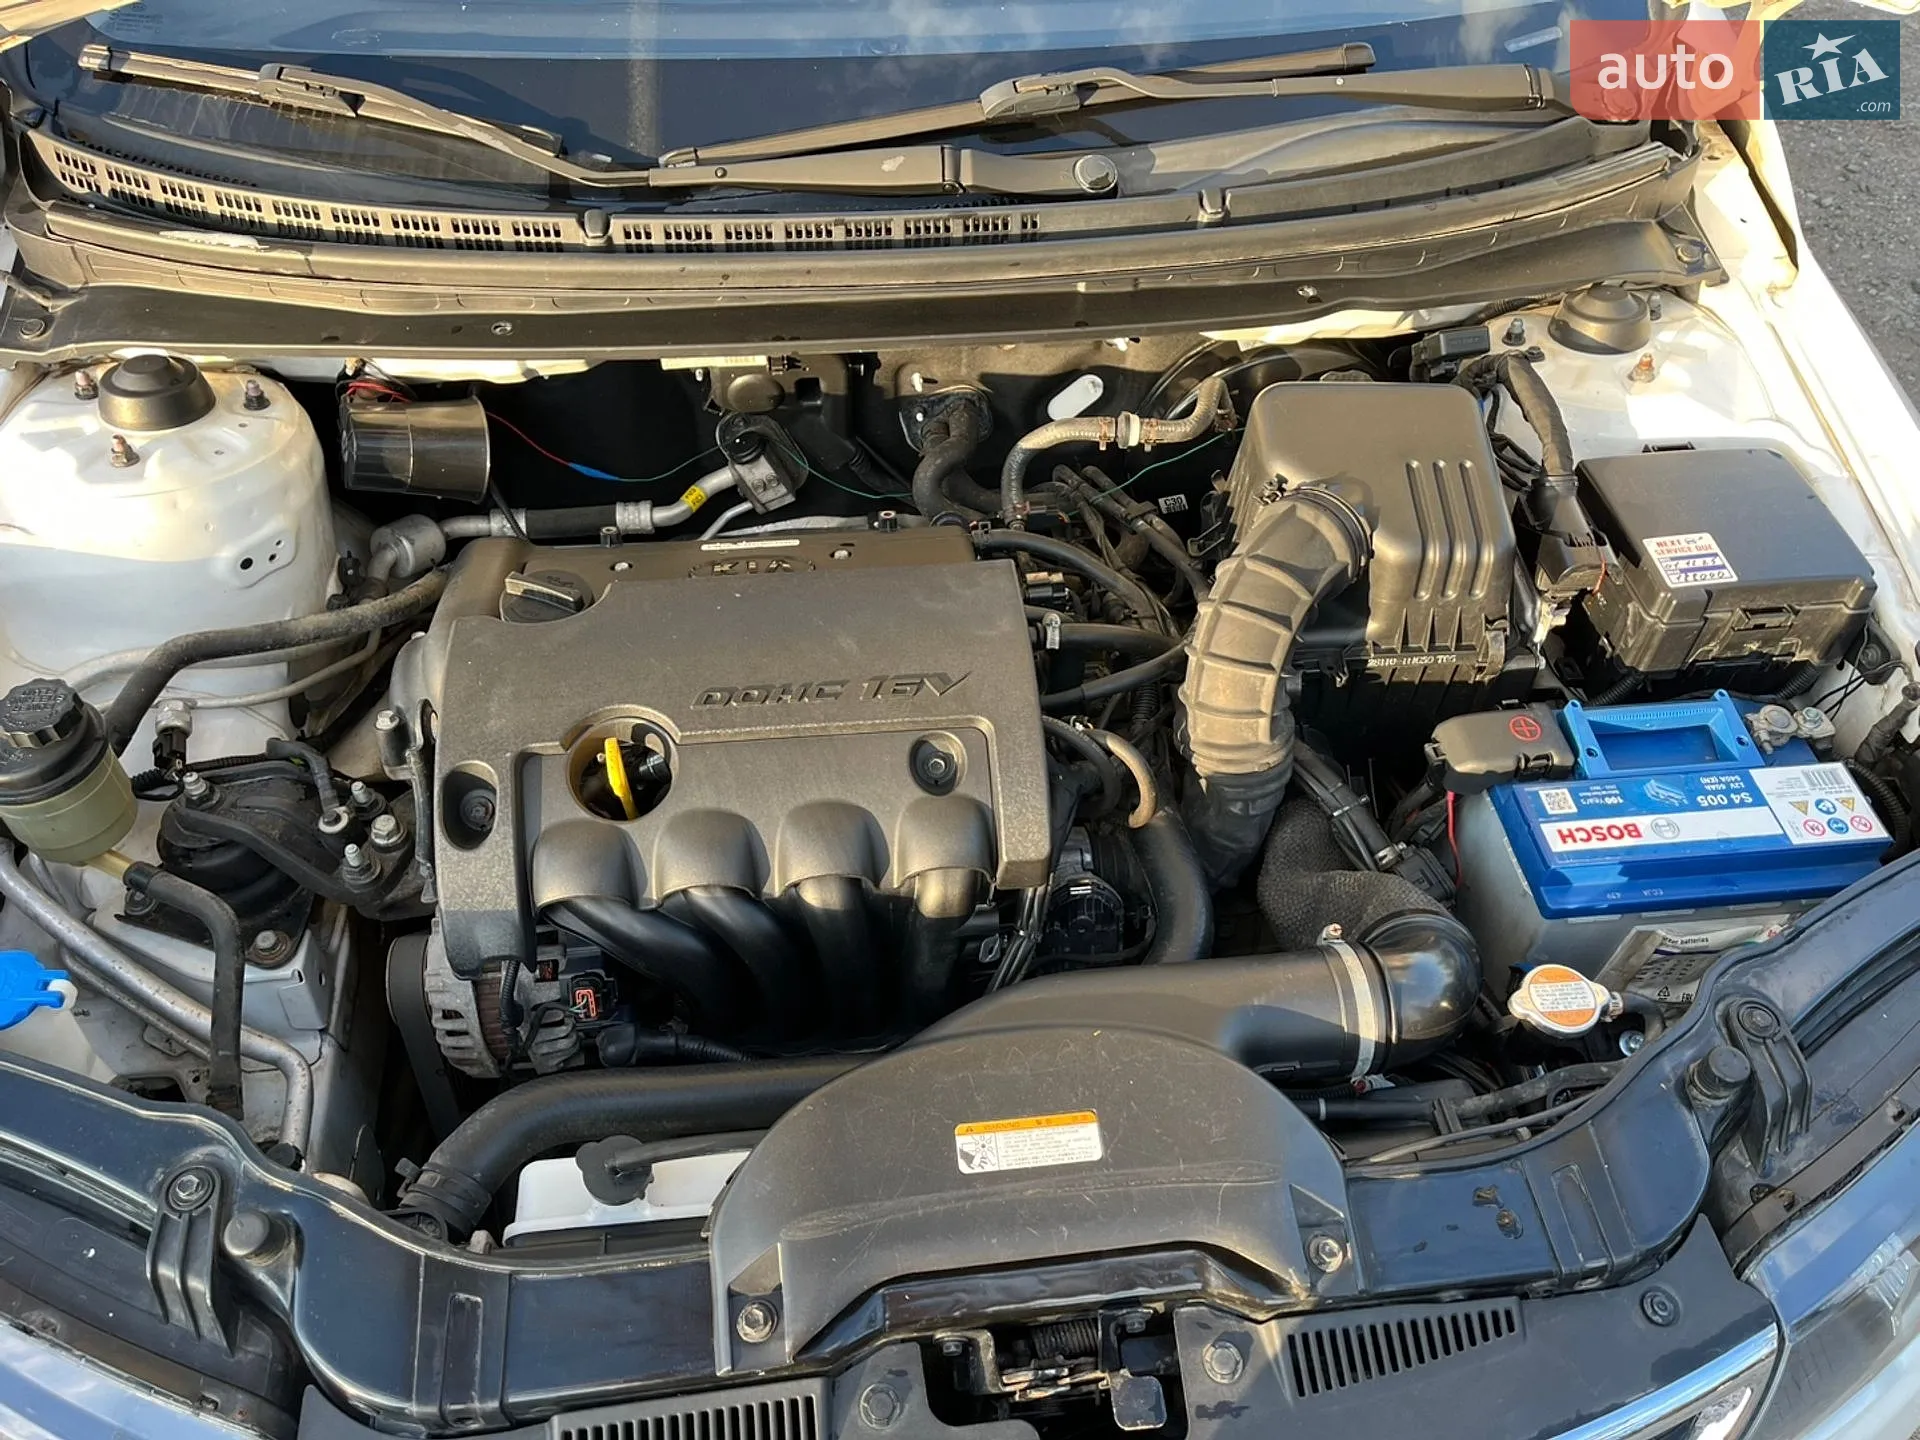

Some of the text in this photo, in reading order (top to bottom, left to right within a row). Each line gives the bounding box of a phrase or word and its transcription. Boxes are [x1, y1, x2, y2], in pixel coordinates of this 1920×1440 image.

[1655, 539, 1682, 548] NEXT
[1655, 543, 1713, 556] SERVICE DUE
[712, 559, 793, 576] KIA
[689, 670, 974, 711] DOHC 16V
[1696, 791, 1753, 807] S4 005
[1557, 822, 1644, 844] BOSCH
